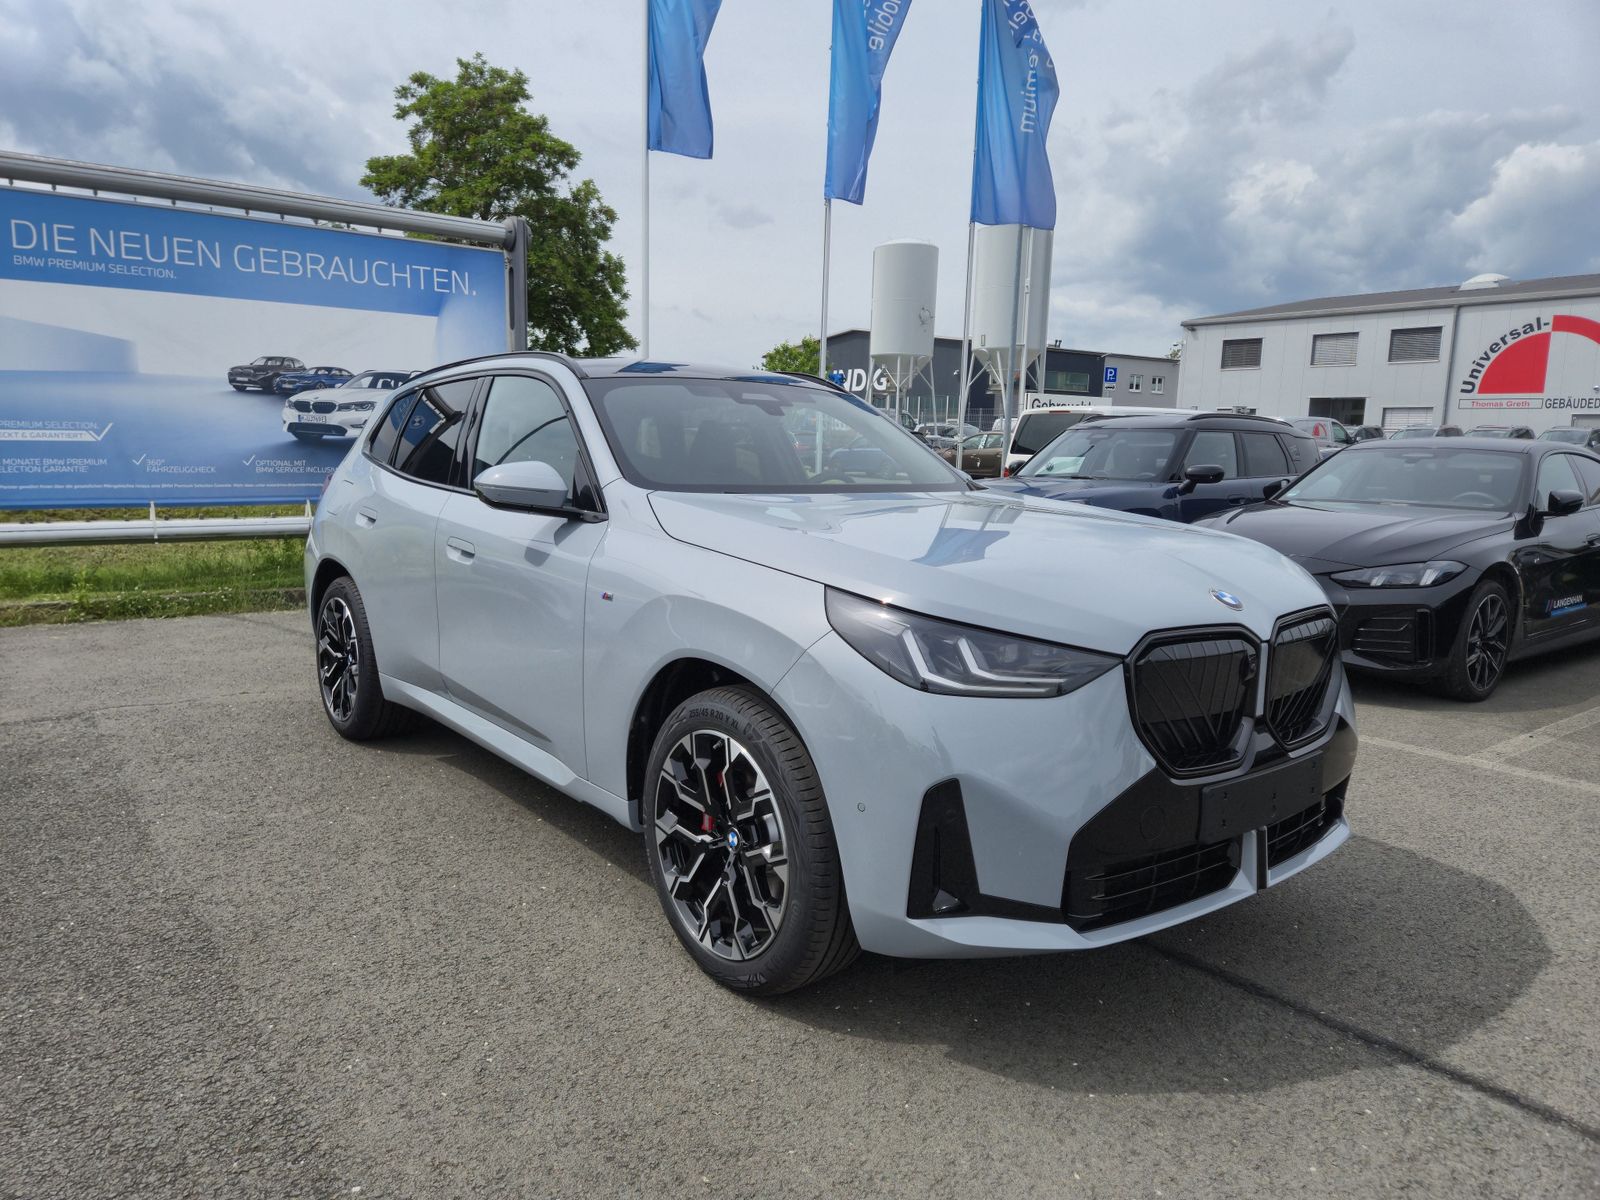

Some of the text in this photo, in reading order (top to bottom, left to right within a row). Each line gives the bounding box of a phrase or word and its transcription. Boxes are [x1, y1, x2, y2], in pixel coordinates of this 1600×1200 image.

[10, 219, 477, 296] DIE NEUEN GEBRAUCHTEN.
[13, 254, 177, 279] BMW PREMIUM SELECTION.
[1460, 317, 1551, 394] Universal-
[1506, 400, 1530, 408] Greth
[31, 432, 83, 440] GARANTIERT
[2, 457, 108, 466] MONATE BMW PREMIUM
[43, 465, 88, 473] GARANTIE
[146, 465, 217, 473] FAHRZEUGCHECK
[1553, 594, 1583, 609] LANGENHAN
